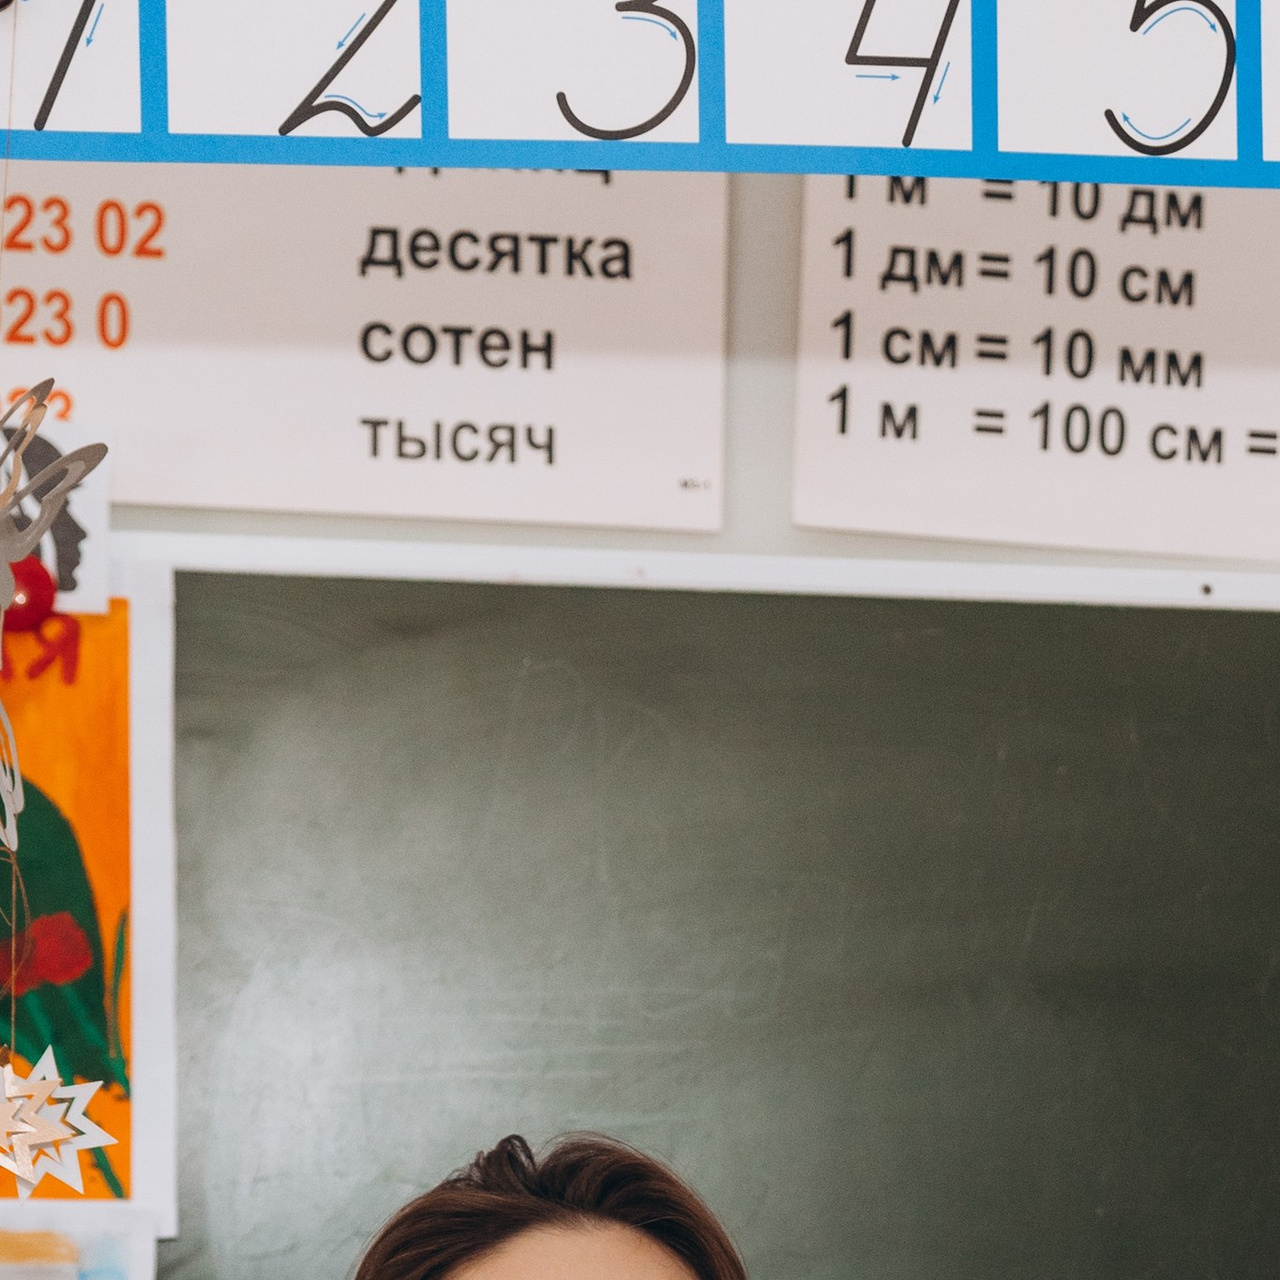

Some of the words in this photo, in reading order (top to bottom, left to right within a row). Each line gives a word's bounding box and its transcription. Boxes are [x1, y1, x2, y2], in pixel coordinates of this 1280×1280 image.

[556, 0, 696, 140] 3
[845, 0, 960, 147] 4
[1105, 0, 1237, 156] 5
[93, 198, 167, 261] 02
[1046, 182, 1101, 221] 10
[1119, 187, 1205, 236] дм
[359, 226, 633, 280] десятка
[832, 227, 856, 279] 1
[879, 245, 965, 294] дм
[1034, 245, 1098, 299] 10
[1119, 265, 1195, 308] см
[95, 290, 131, 350] 0
[360, 321, 555, 371] сотен
[831, 309, 854, 361] 1
[881, 326, 959, 370] см
[1032, 326, 1096, 379] 10
[1118, 346, 1204, 388] мм
[360, 418, 555, 466] тысяч
[828, 384, 849, 436] 1
[880, 402, 919, 441] м
[1031, 401, 1127, 457] 100
[1150, 423, 1224, 465] см
